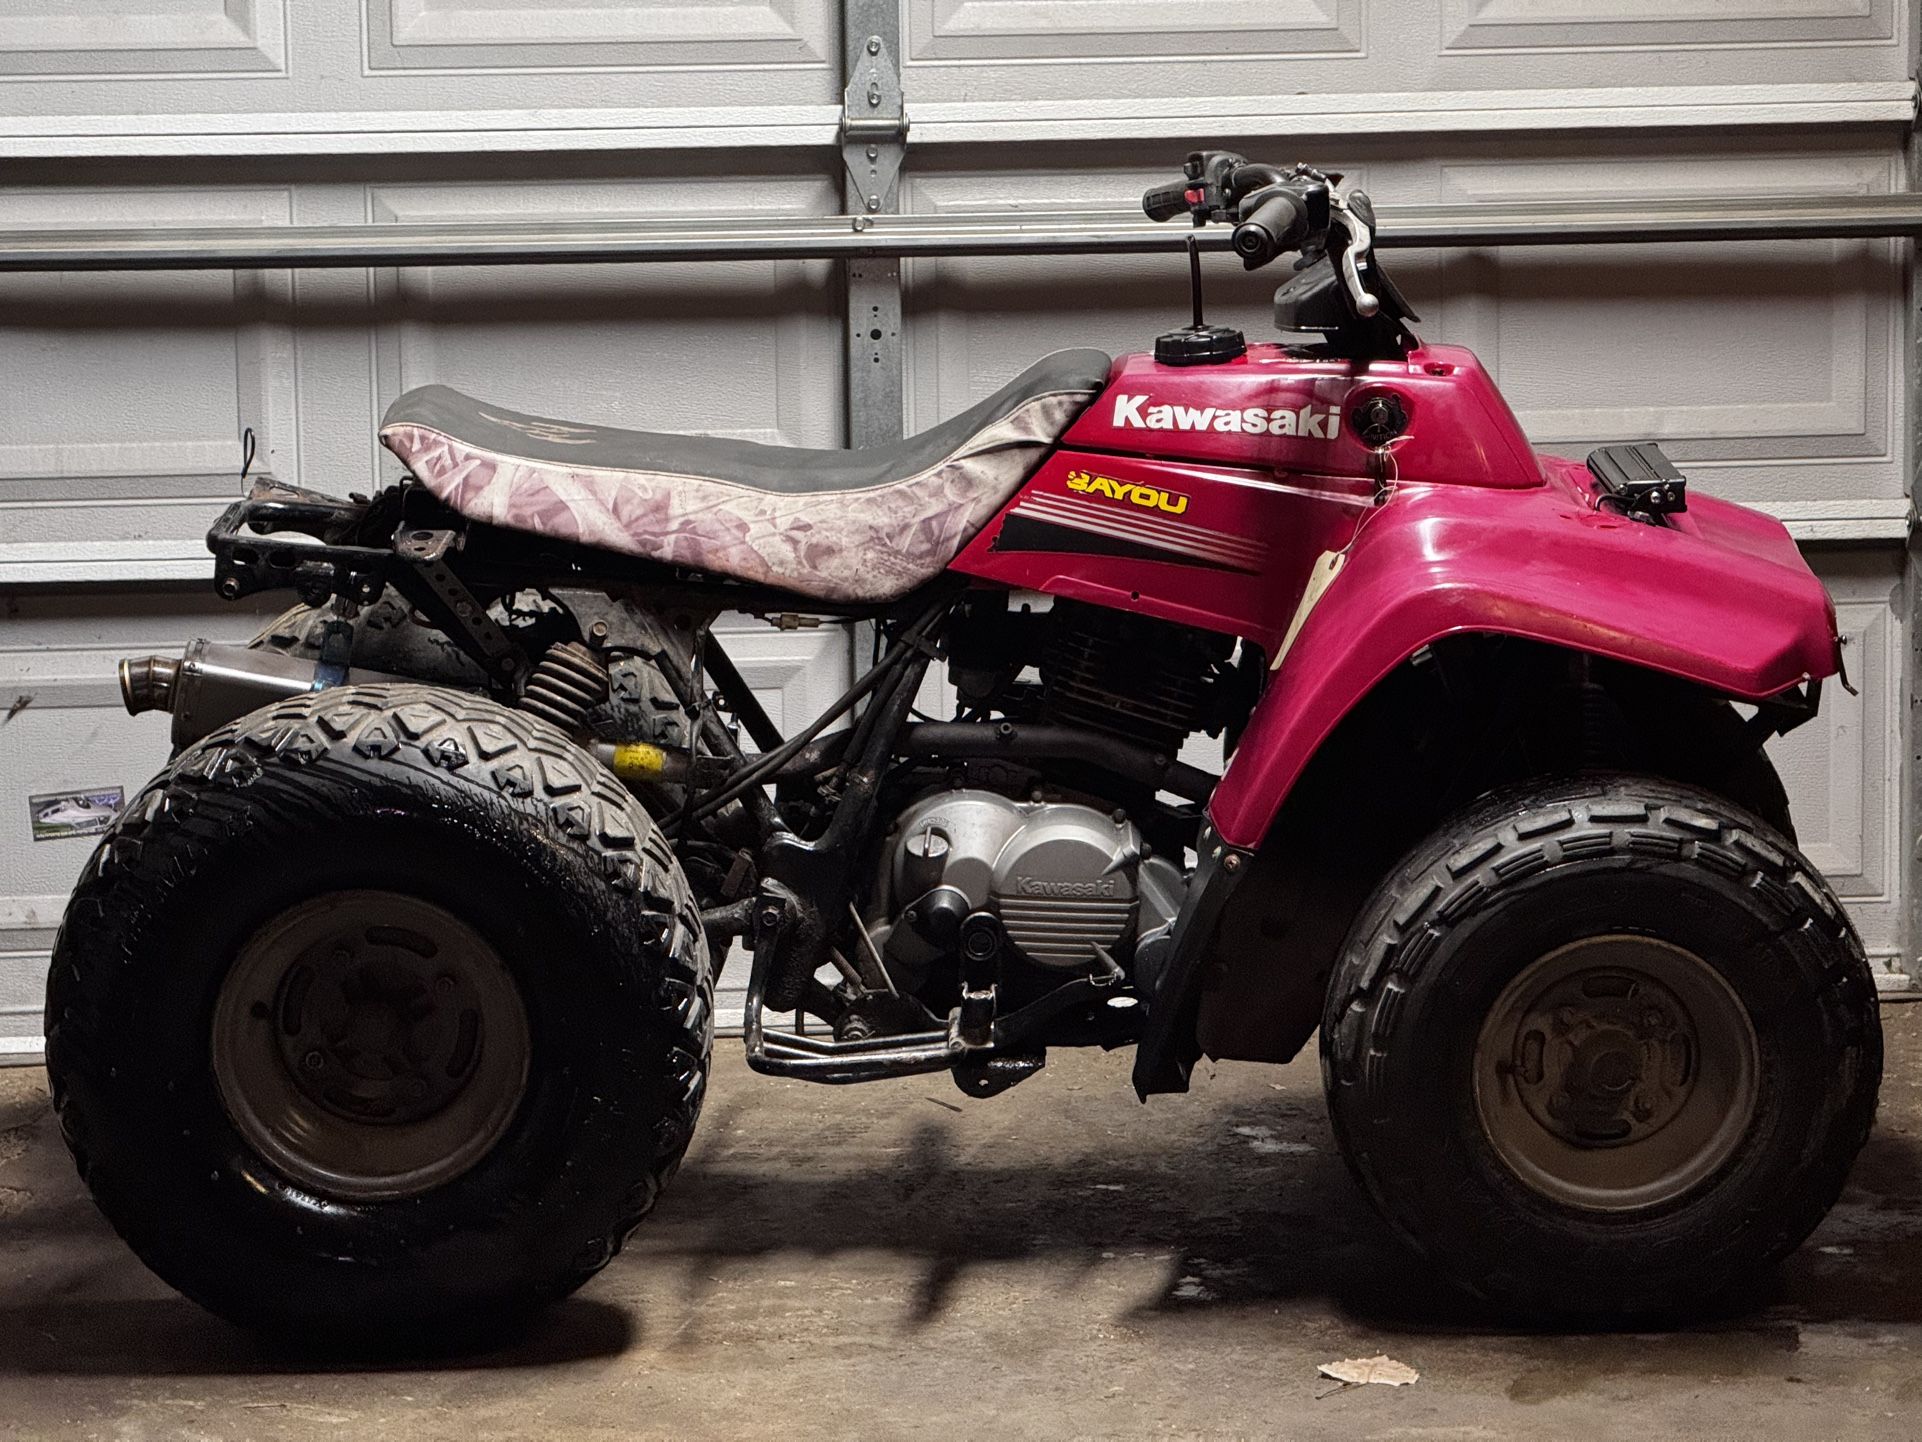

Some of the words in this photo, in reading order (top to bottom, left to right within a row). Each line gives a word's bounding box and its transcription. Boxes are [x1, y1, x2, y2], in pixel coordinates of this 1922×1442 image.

[1112, 394, 1341, 440] Kawasaki
[1066, 471, 1188, 515] BAYOU
[1016, 876, 1115, 898] Kawasaki
